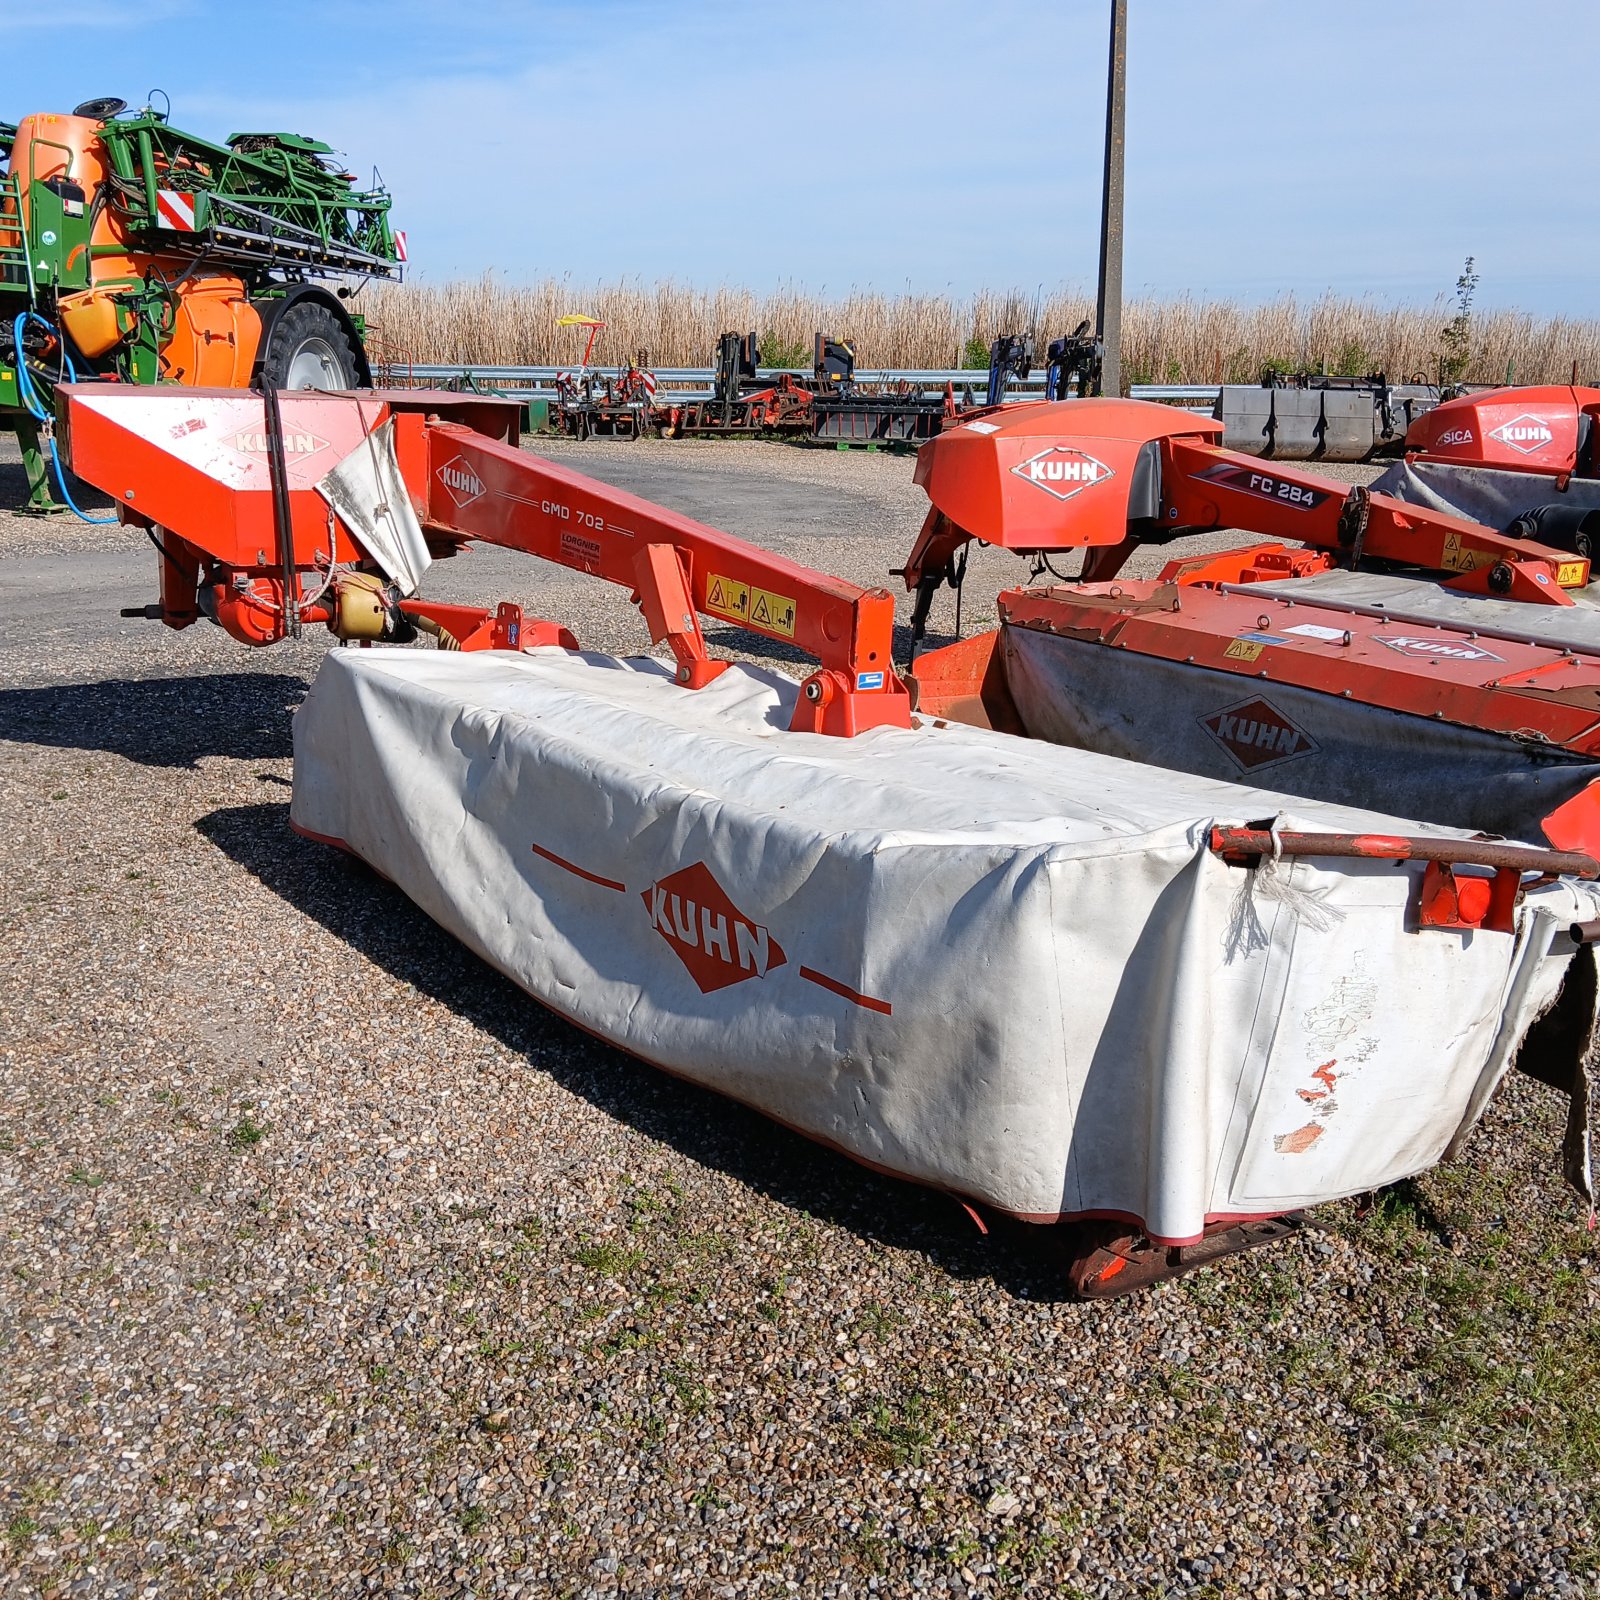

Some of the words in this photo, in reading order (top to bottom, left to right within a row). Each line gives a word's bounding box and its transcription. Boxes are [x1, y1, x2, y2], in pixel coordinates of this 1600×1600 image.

[1443, 429, 1473, 443] SICA
[443, 466, 479, 496] KUHN
[1030, 461, 1097, 481] KUHN
[1250, 474, 1273, 493] FC
[1278, 483, 1314, 506] 284
[541, 500, 570, 520] GMD
[576, 510, 604, 531] 702
[562, 533, 600, 553] LORGNIER
[1389, 637, 1487, 660] KUHN
[1216, 713, 1301, 755] KUHN
[651, 880, 769, 979] KUHN
